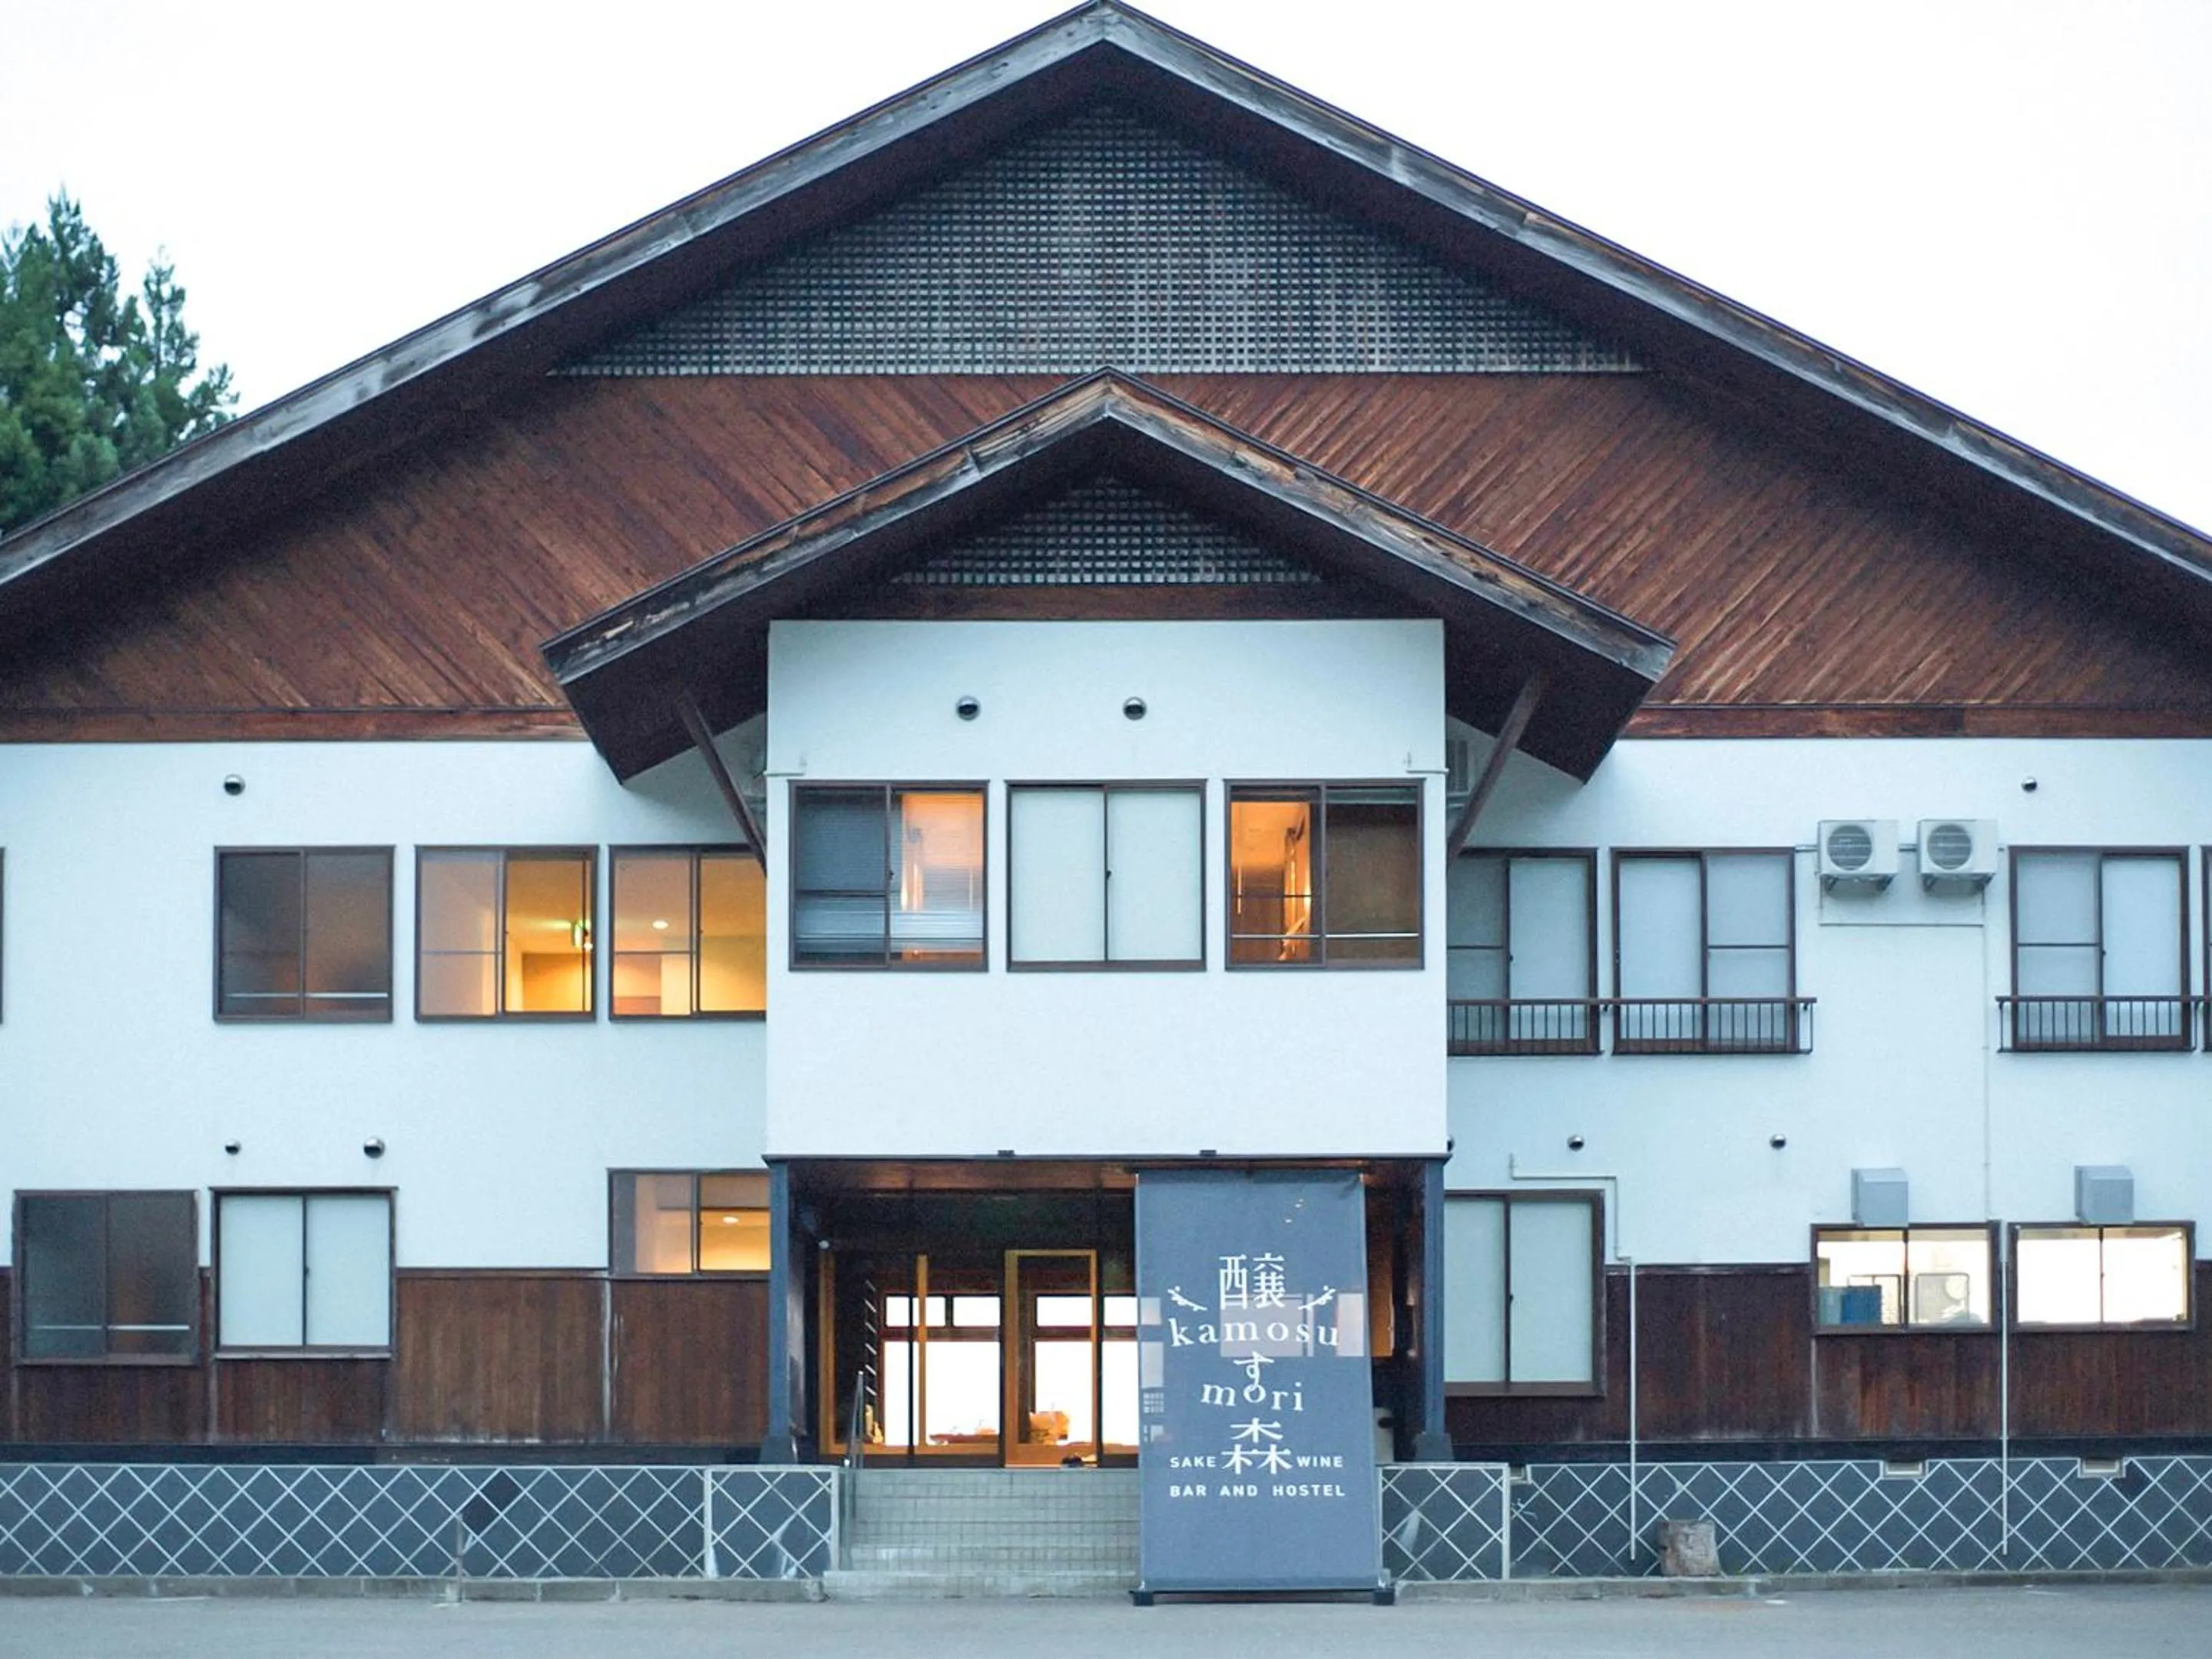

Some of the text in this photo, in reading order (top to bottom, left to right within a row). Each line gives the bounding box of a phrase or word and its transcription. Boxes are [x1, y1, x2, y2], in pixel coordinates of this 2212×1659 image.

[1167, 1317, 1339, 1348] kamosu
[1233, 1350, 1274, 1391] す
[1200, 1382, 1304, 1412] mori
[1220, 1417, 1293, 1475] 森
[1170, 1455, 1217, 1469] SAKE
[1296, 1455, 1343, 1469] WINE
[1169, 1484, 1346, 1498] BAR AND HOSTEL
